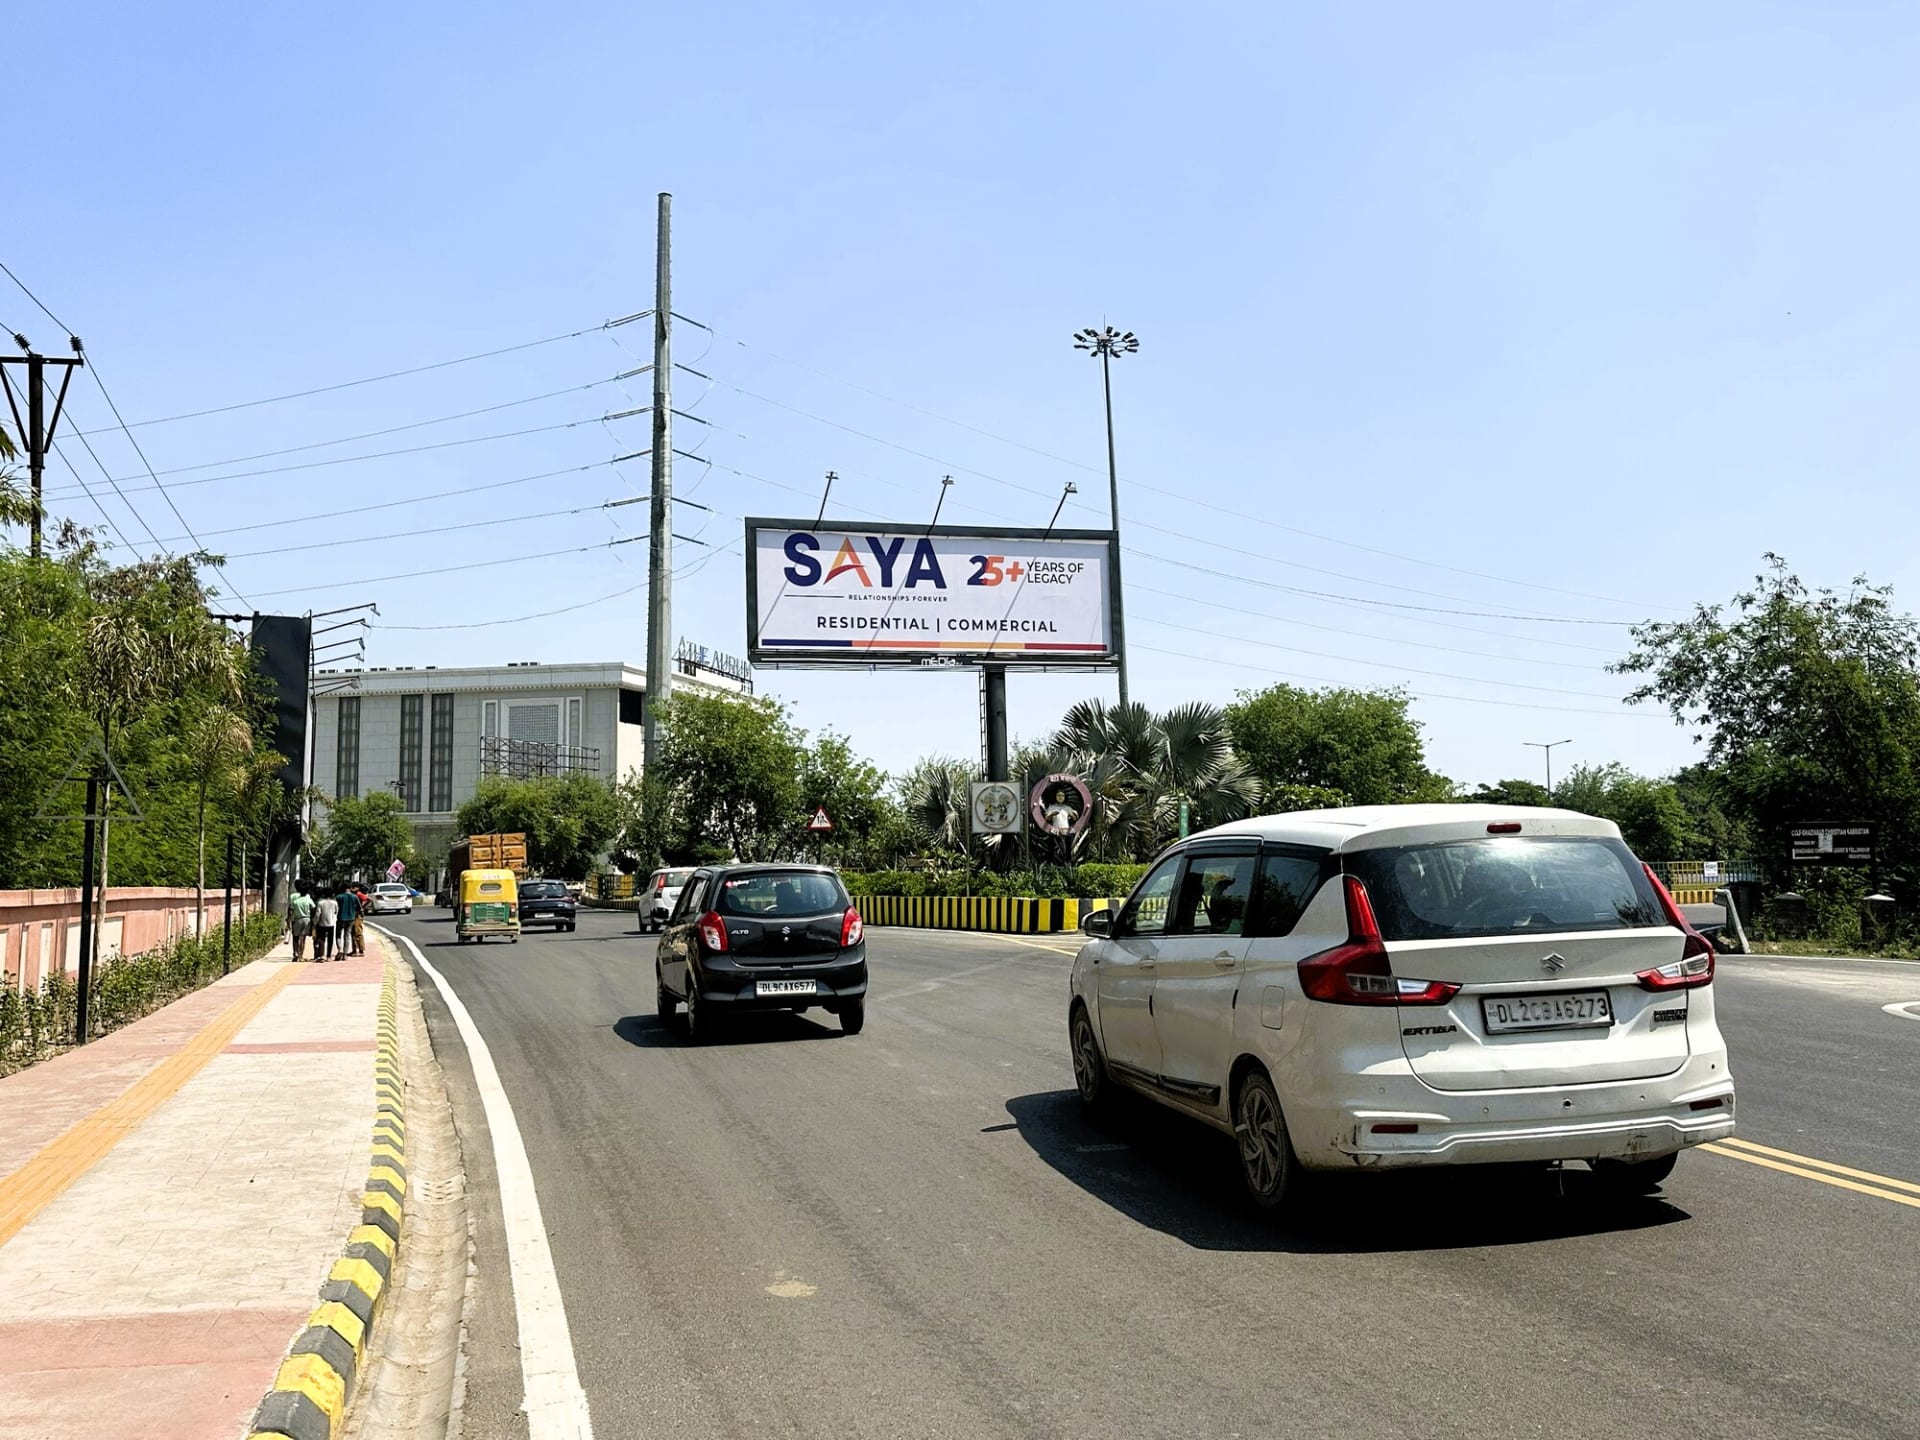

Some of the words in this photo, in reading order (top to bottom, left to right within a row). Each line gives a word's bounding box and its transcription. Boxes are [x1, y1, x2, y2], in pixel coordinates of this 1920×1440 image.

[784, 532, 947, 589] SAYA
[967, 555, 1024, 587] 25+
[1027, 562, 1065, 573] YEARS
[1068, 563, 1084, 573] OF
[1027, 573, 1073, 584] LEGACY
[848, 594, 910, 602] RELATIONSHIPS
[817, 616, 929, 630] RESIDENTIAL
[947, 618, 1058, 633] COMMERCIAL
[1403, 1025, 1457, 1035] ERTIGA
